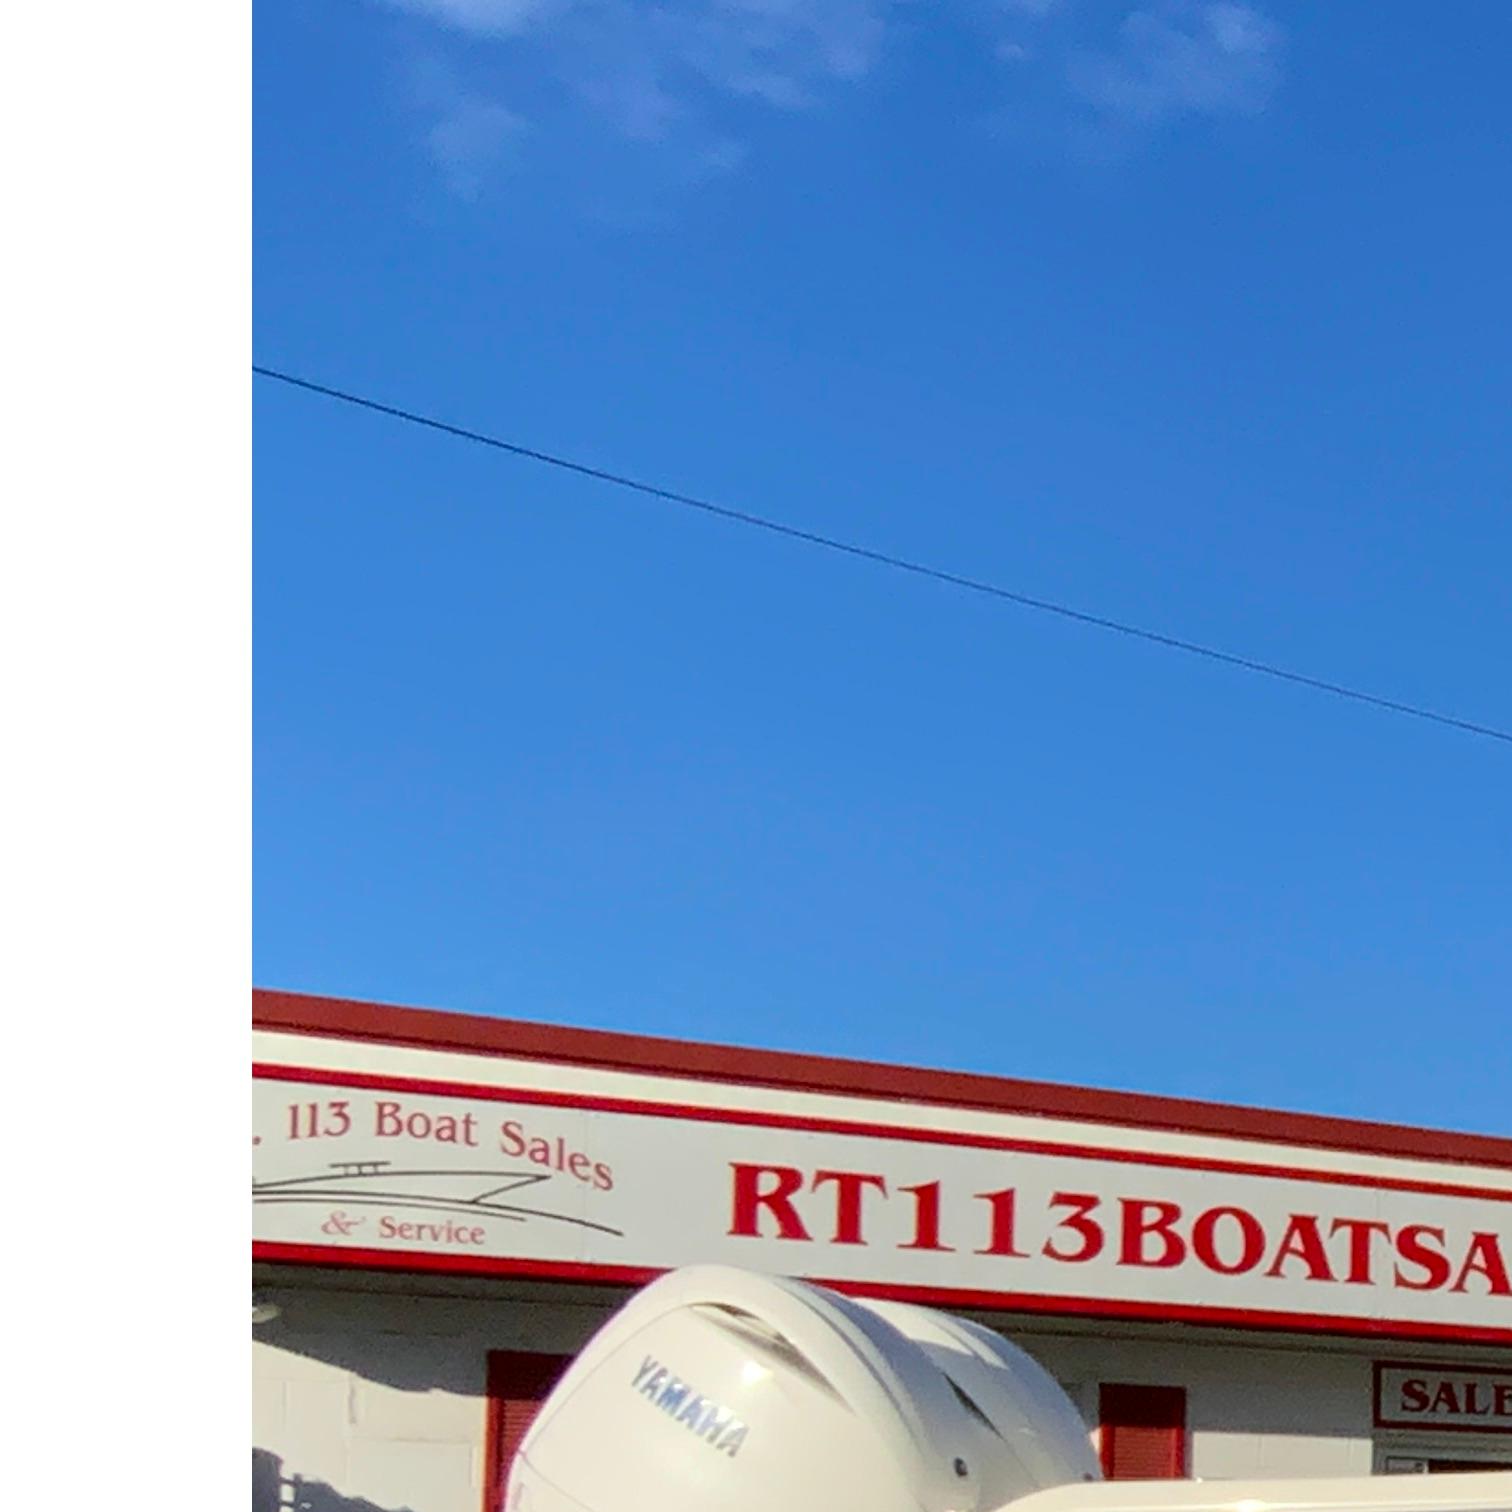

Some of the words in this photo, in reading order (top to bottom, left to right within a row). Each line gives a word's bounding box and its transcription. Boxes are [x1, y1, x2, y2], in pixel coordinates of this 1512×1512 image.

[288, 1101, 352, 1140] 113
[374, 1101, 479, 1147] Boat
[501, 1120, 614, 1191] Sales
[320, 1210, 367, 1236] &
[379, 1215, 486, 1245] Service
[631, 1355, 749, 1458] YAMAHA
